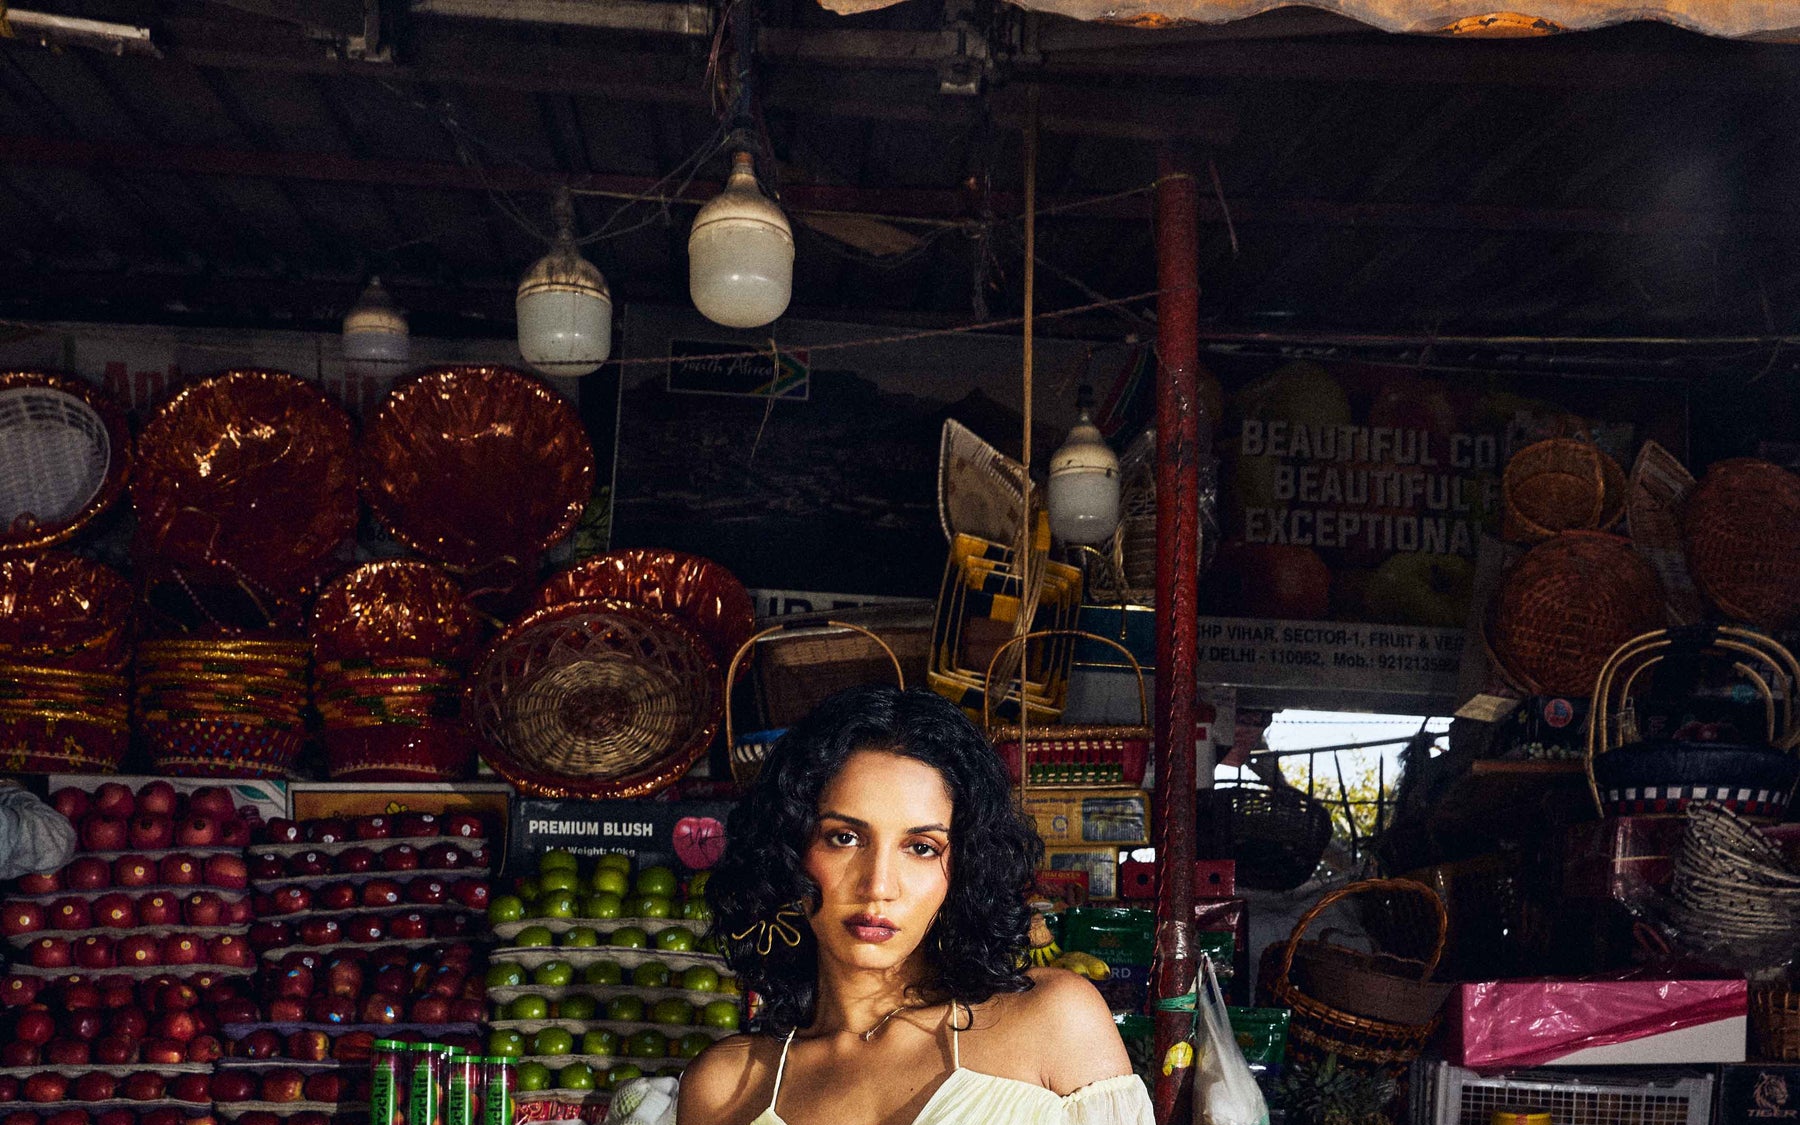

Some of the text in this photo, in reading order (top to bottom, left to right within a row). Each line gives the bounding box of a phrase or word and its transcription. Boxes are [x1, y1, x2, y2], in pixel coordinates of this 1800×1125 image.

[1242, 418, 1498, 470] BEAUTIFUL CO
[1274, 465, 1471, 512] BEAUTIFUL
[1370, 632, 1414, 648] FRUIT
[1210, 647, 1255, 662] DELHI
[529, 820, 653, 837] PREMIUM BLUSH
[568, 846, 608, 857] Weight:
